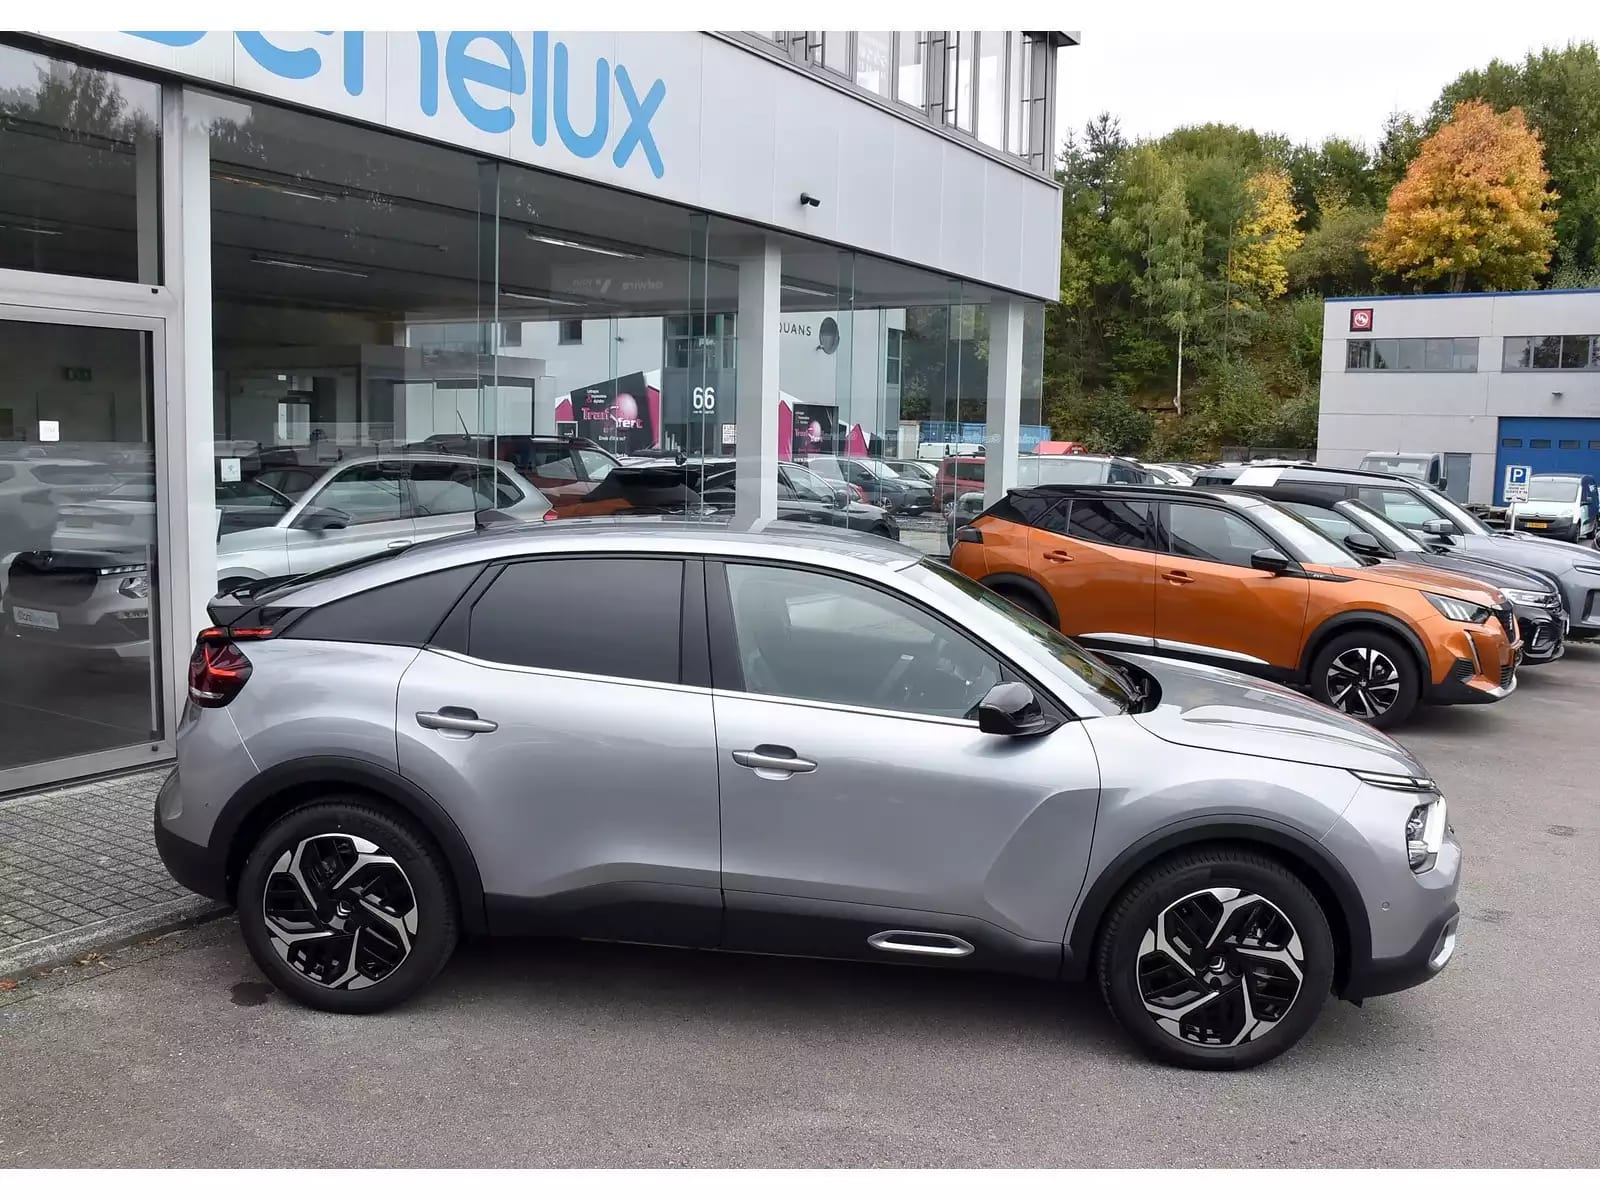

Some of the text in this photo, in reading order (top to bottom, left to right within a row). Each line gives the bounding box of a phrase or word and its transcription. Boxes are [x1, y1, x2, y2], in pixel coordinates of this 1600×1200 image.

[117, 31, 667, 179] nelux
[693, 386, 715, 410] 66
[1512, 468, 1524, 482] P
